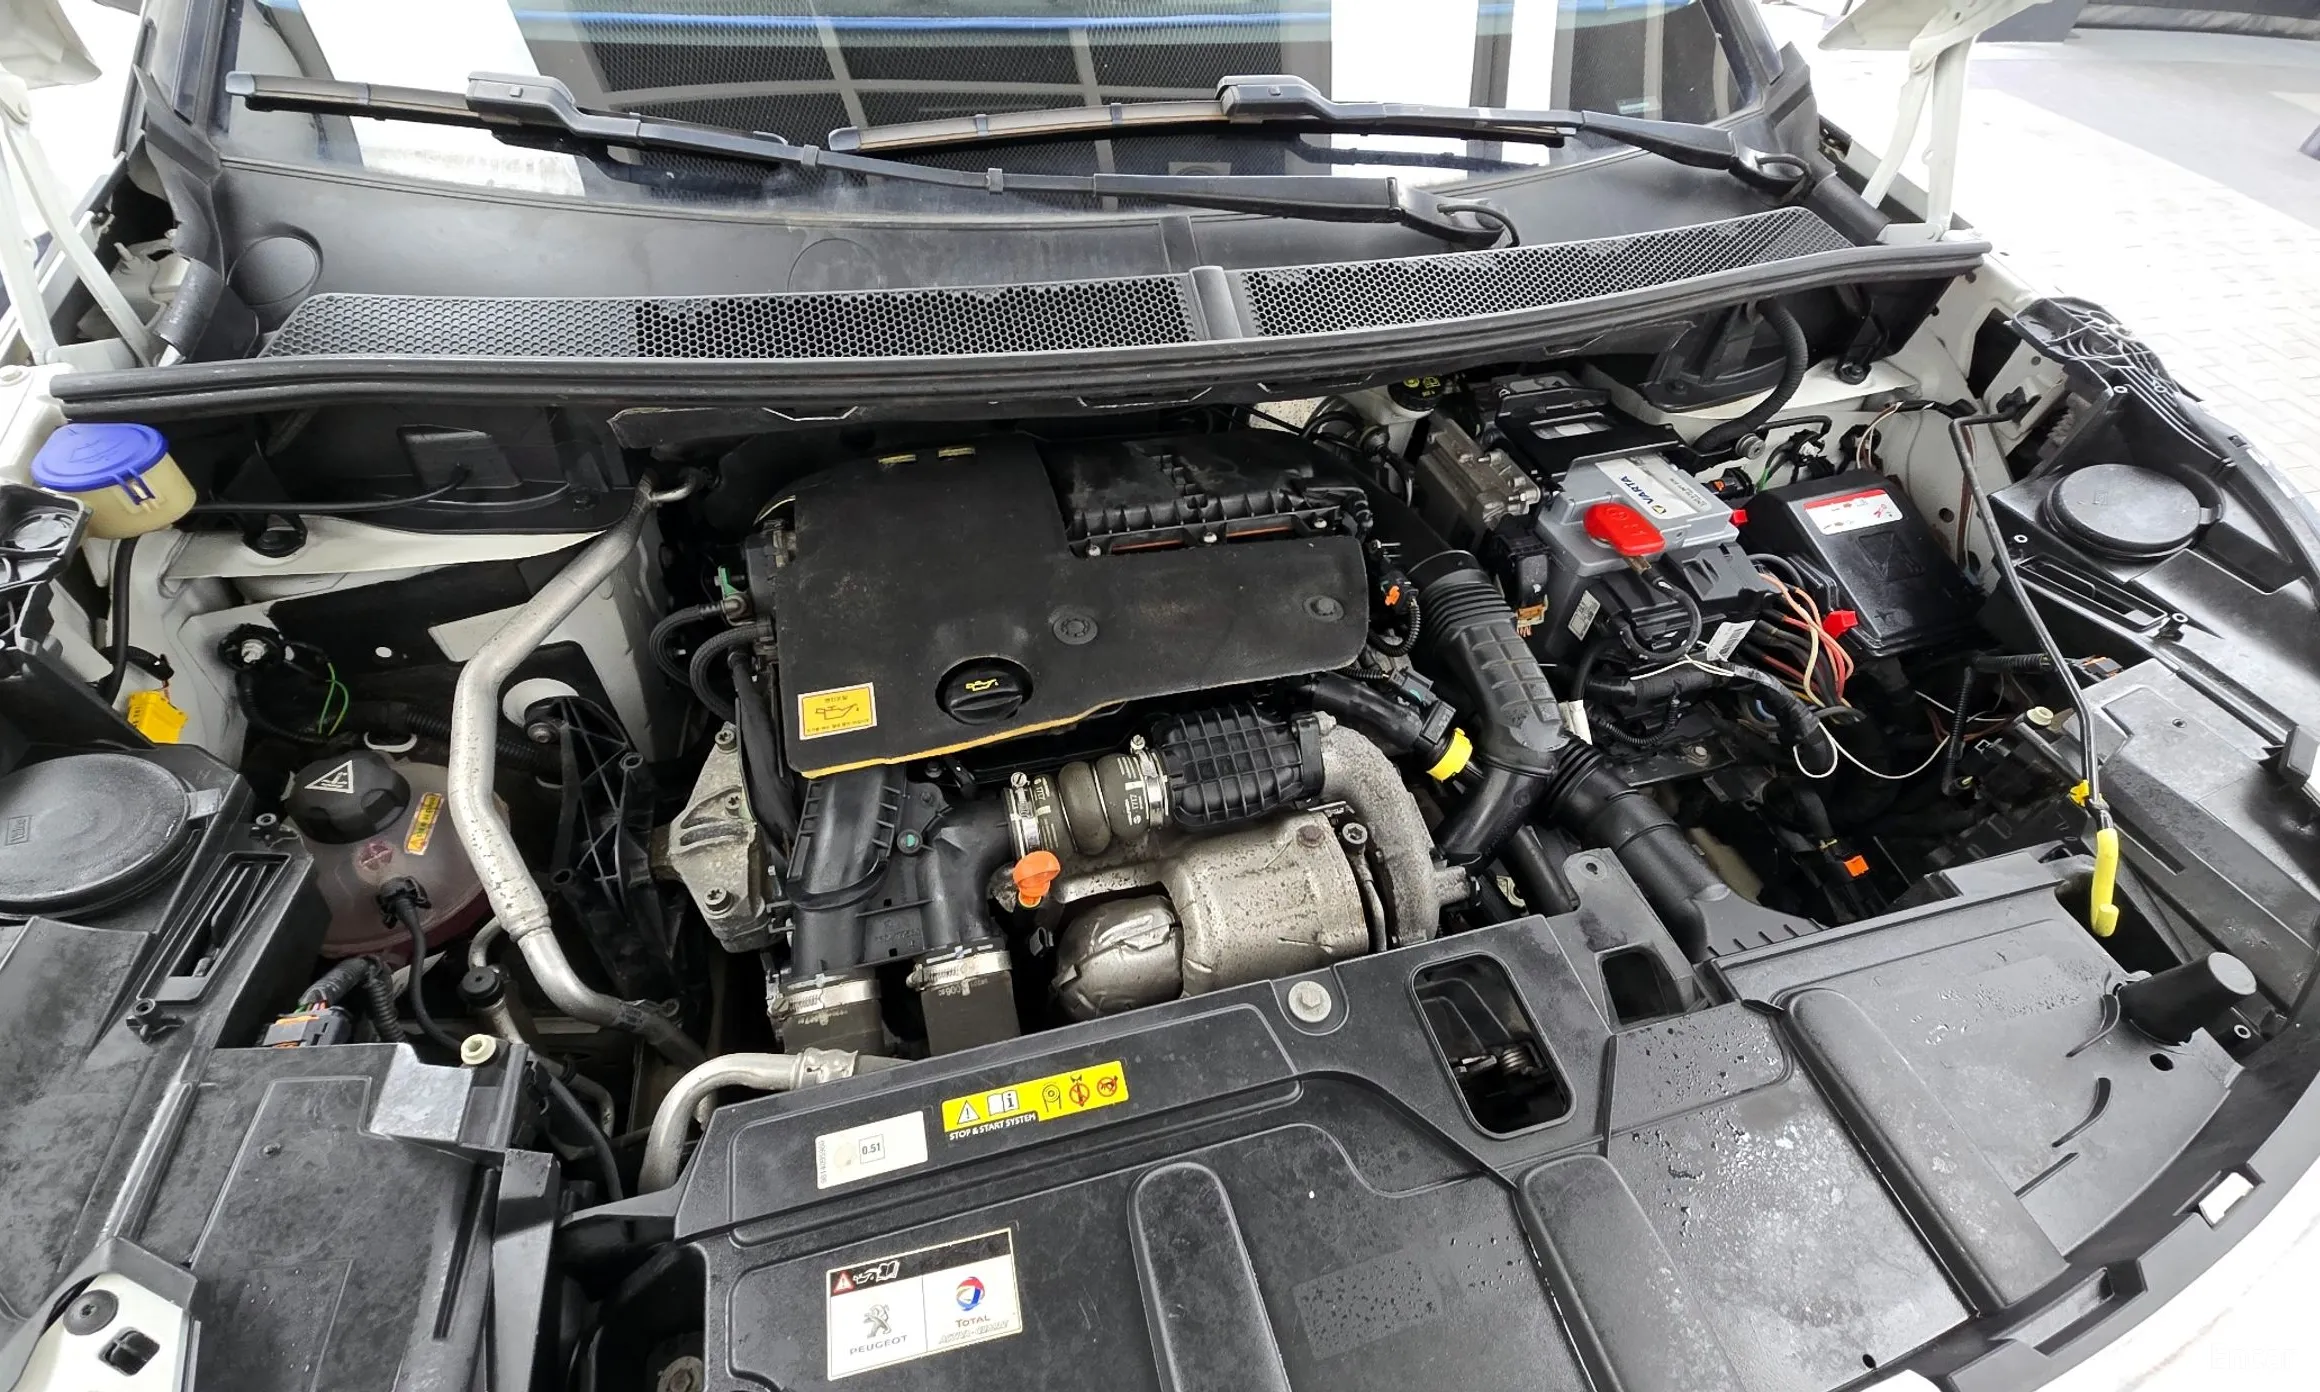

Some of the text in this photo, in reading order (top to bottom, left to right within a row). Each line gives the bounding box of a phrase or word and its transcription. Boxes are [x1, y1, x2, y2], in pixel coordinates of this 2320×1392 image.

[1621, 476, 1654, 504] VARTA
[949, 1113, 1036, 1141] STOP & START SYSTEM
[861, 1142, 881, 1155] 0.51
[955, 1314, 991, 1328] TOTAL
[849, 1334, 908, 1355] PEUGEOT
